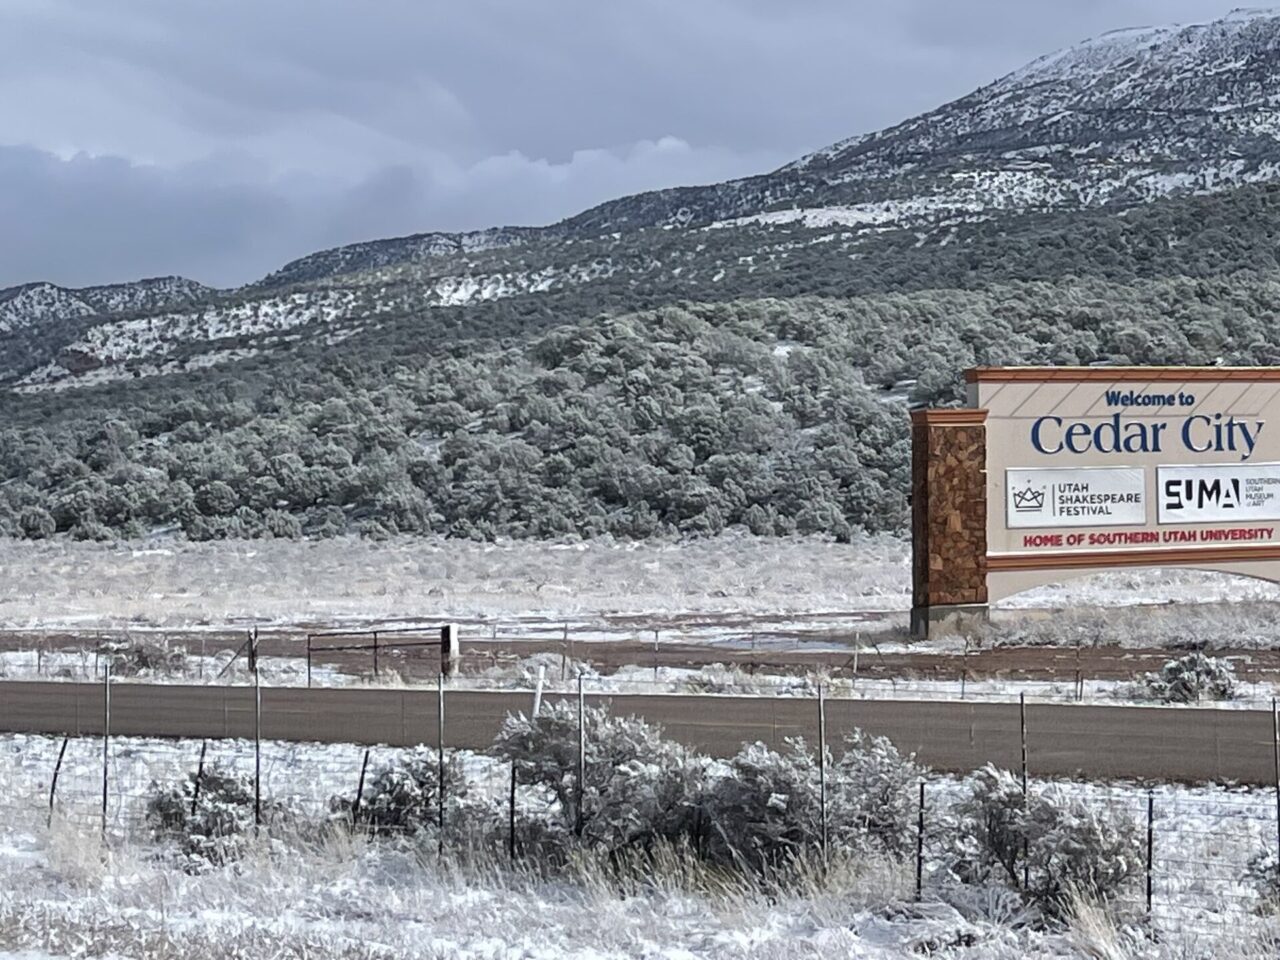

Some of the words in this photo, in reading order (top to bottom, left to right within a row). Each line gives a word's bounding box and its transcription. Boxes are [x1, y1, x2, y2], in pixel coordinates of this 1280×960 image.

[1105, 391, 1175, 407] Welcome
[1178, 391, 1195, 406] to
[1030, 413, 1167, 455] Cedar
[1181, 413, 1265, 460] City
[1058, 483, 1089, 493] UTAH
[1165, 478, 1241, 510] SUMA
[1058, 493, 1141, 505] SHAKESPEARE
[1059, 505, 1112, 517] FESTIVAL
[1023, 535, 1063, 548] HOME
[1066, 533, 1086, 546] OF
[1088, 531, 1160, 545] SOUTHERN
[1162, 530, 1197, 543] UTAH
[1200, 528, 1274, 541] UNIVERSITY
